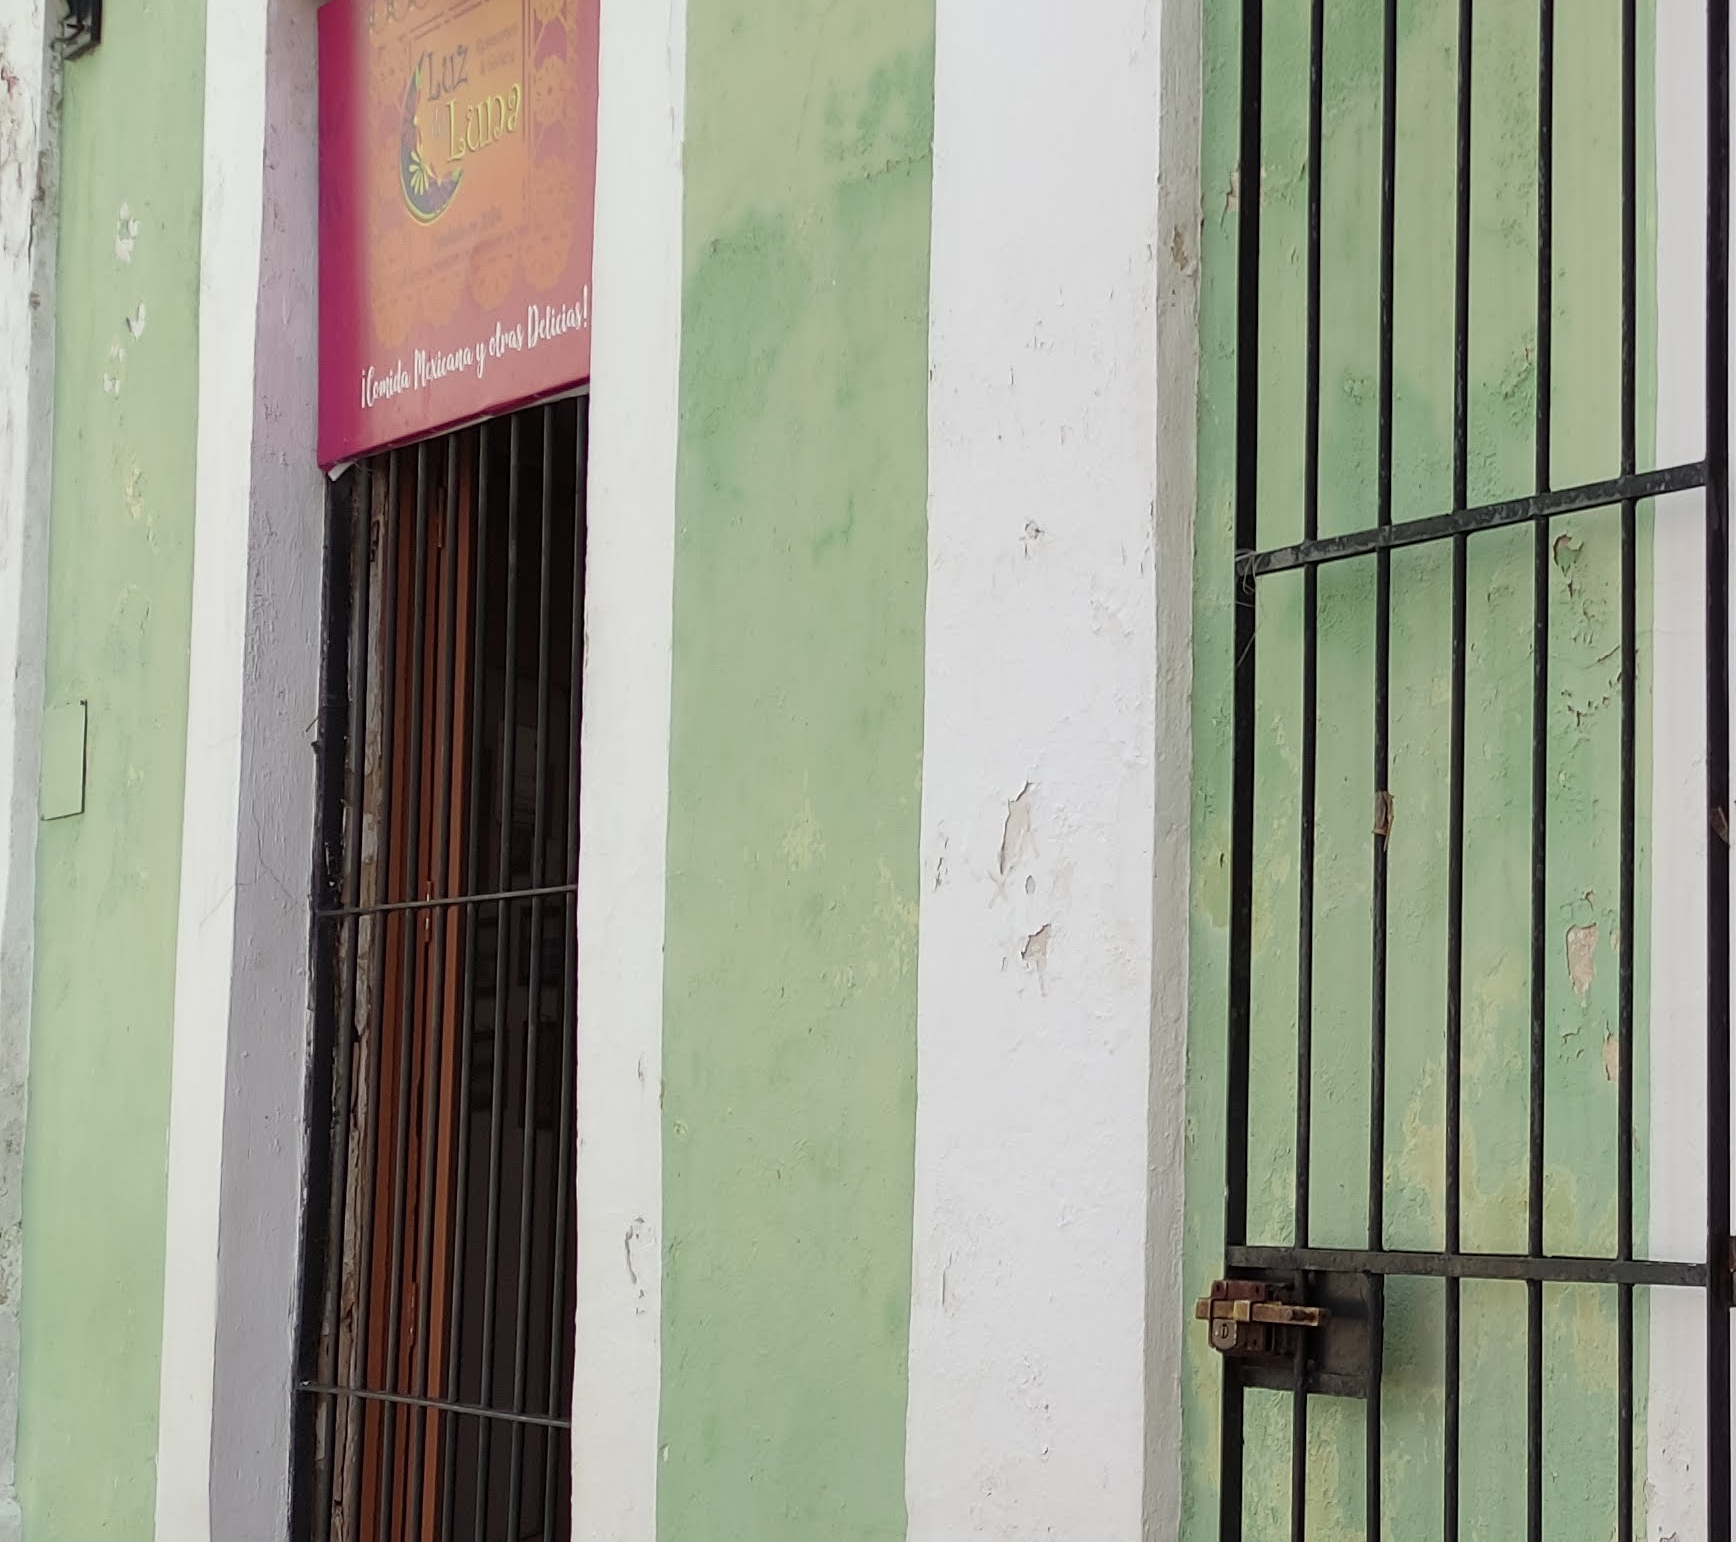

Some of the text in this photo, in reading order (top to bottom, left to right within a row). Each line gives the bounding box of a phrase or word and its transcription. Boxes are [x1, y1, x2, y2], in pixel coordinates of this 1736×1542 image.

[446, 82, 521, 163] Luna
[361, 284, 588, 409] ¡Comida Mexicana y otras Delicias!
